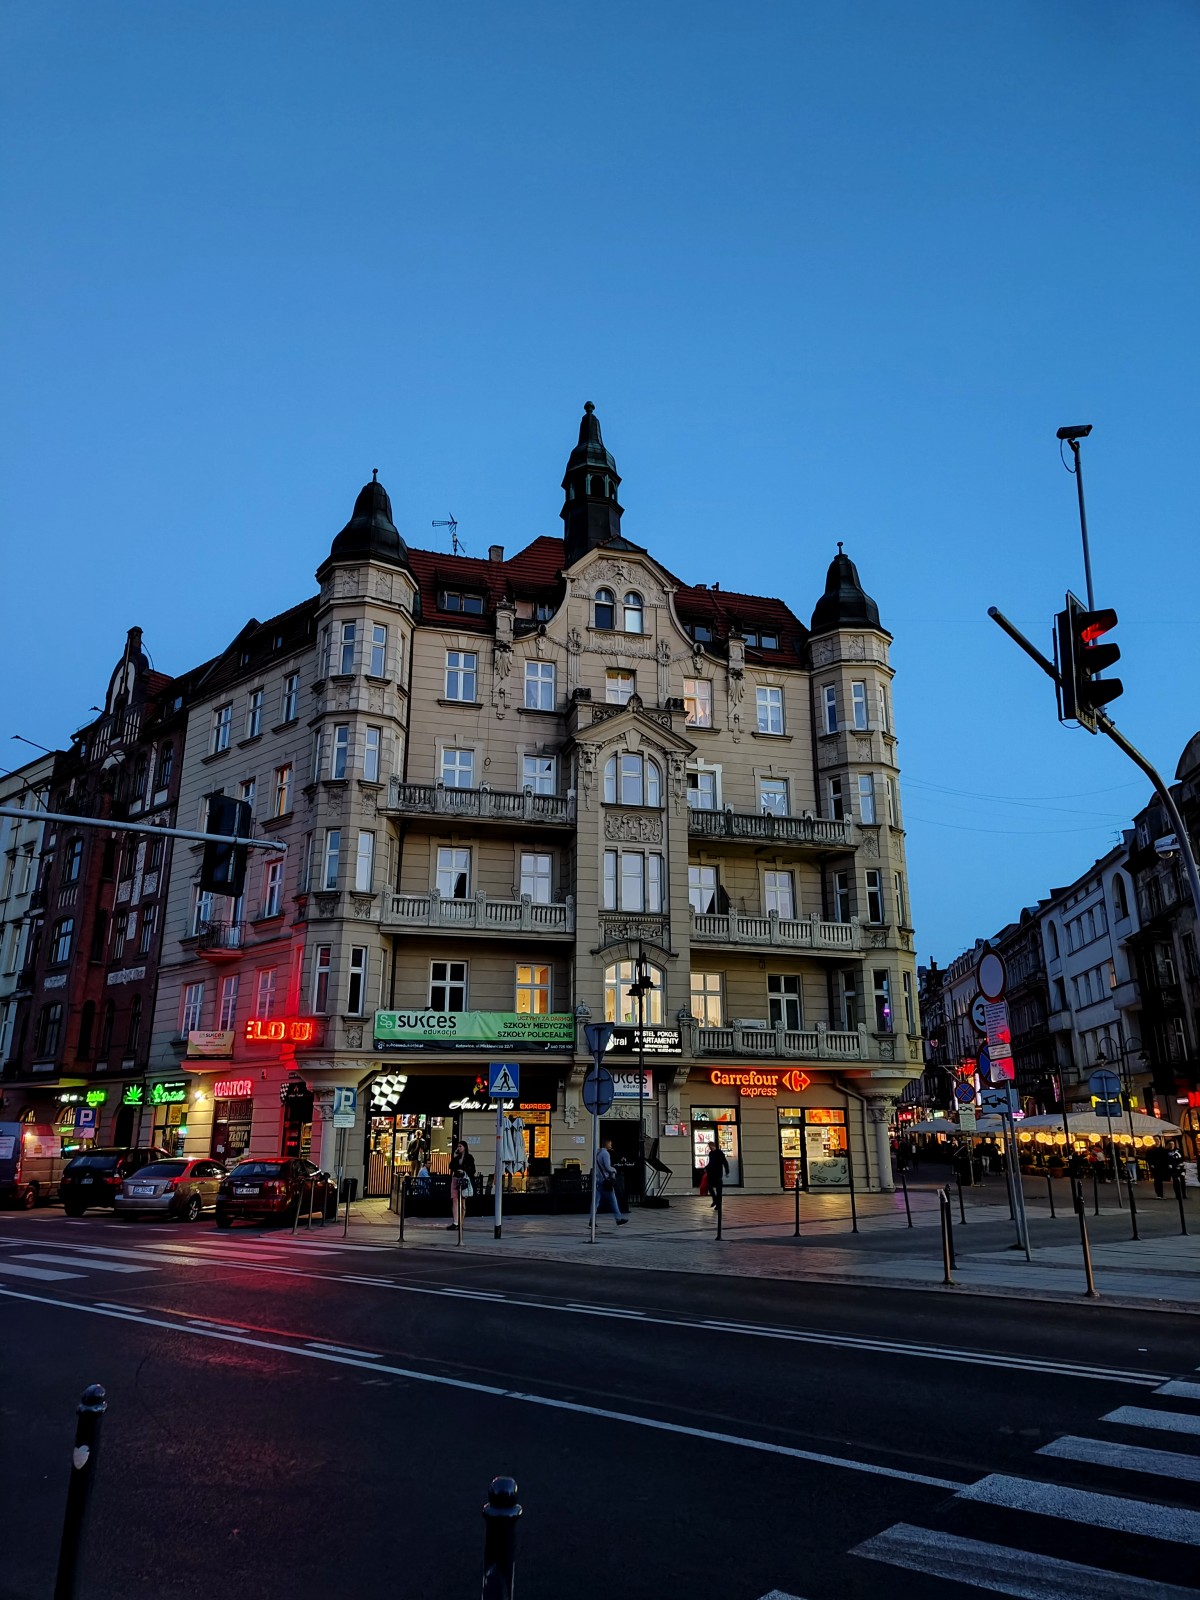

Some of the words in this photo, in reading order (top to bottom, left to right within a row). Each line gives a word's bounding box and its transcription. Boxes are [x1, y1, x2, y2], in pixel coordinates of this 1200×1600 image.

[423, 1028, 457, 1037] edukacja
[634, 1036, 679, 1045] AARTAMENTY
[711, 1070, 779, 1086] Carrefour
[214, 1080, 252, 1097] KANTOR
[740, 1087, 778, 1098] express
[340, 1090, 353, 1111] P
[449, 1096, 481, 1110] Amir
[80, 1110, 92, 1126] P
[228, 1131, 248, 1142] ZŁOTA
